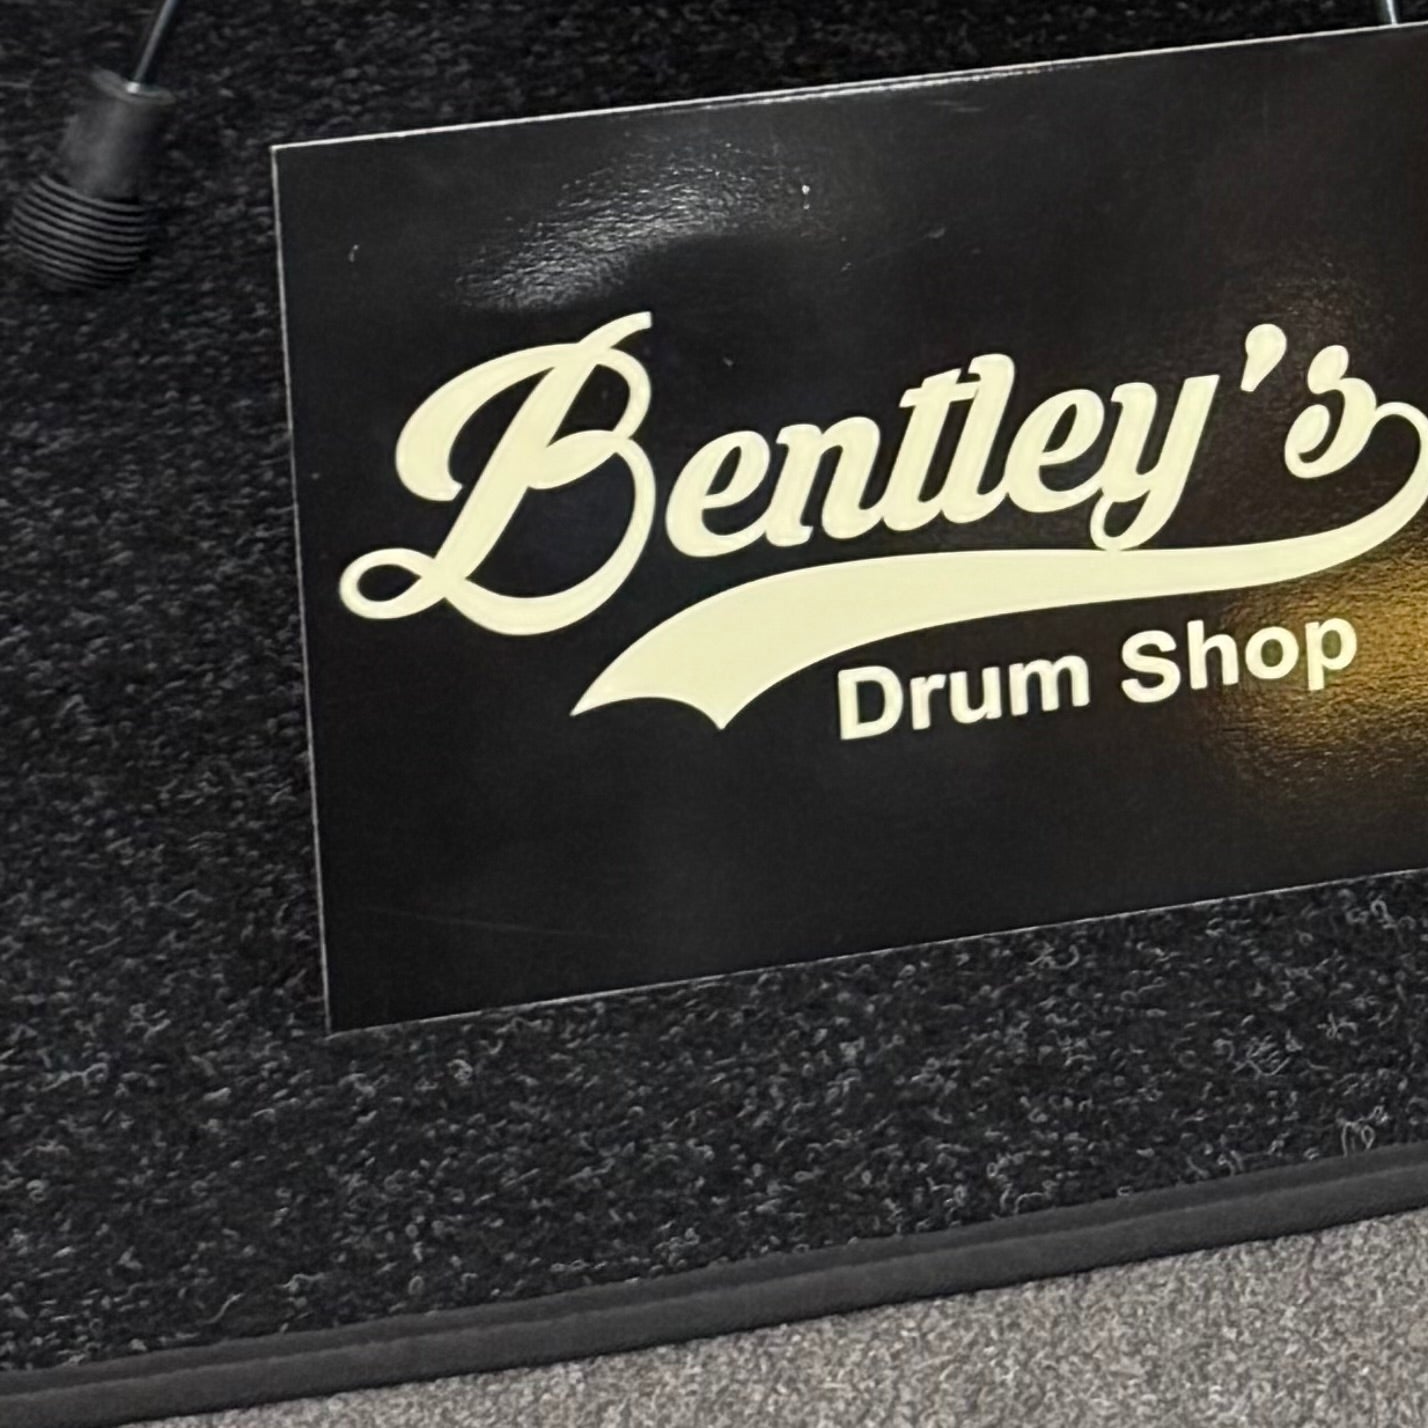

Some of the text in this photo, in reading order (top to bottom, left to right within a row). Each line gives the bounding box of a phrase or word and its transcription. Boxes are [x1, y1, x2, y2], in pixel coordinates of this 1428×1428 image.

[338, 309, 1390, 637] Bentley's
[836, 614, 1358, 742] Drum Shop
